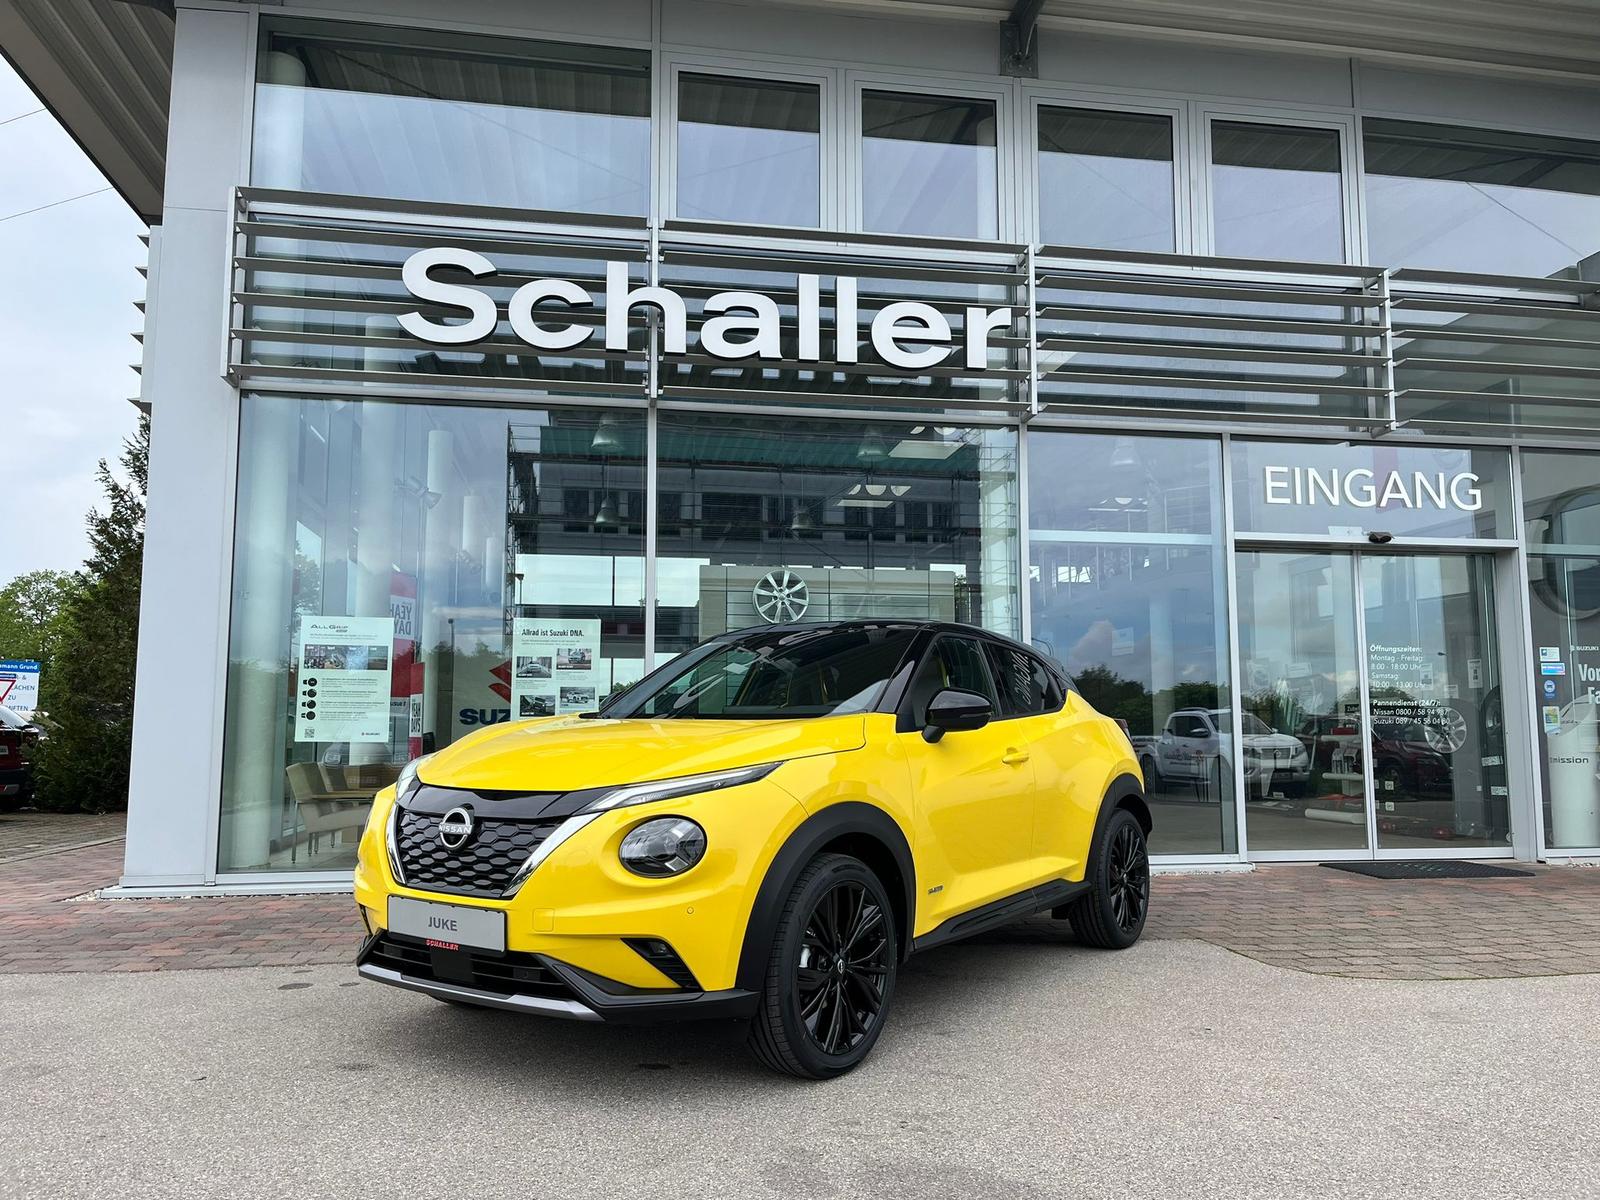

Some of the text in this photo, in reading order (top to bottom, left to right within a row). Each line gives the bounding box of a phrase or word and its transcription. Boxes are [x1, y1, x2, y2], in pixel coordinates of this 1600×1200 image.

[396, 246, 1012, 370] Schaller
[1264, 465, 1483, 512] EINGANG
[521, 628, 585, 637] Allrad ist Suzuki DNA.
[1370, 654, 1396, 663] Montag
[1400, 655, 1423, 664] Freitag
[19, 663, 38, 671] Grund
[1409, 663, 1422, 671] Uhr
[1371, 672, 1399, 681] Samstag
[1372, 699, 1417, 707] Pannendienst
[1373, 708, 1395, 716] Nissan
[1395, 708, 1412, 716] 0800
[1417, 708, 1426, 716] 58
[1373, 717, 1395, 725] Suzuki
[438, 823, 472, 834] NISSAN
[428, 916, 458, 931] JUKE
[425, 939, 460, 951] SCHALLER
